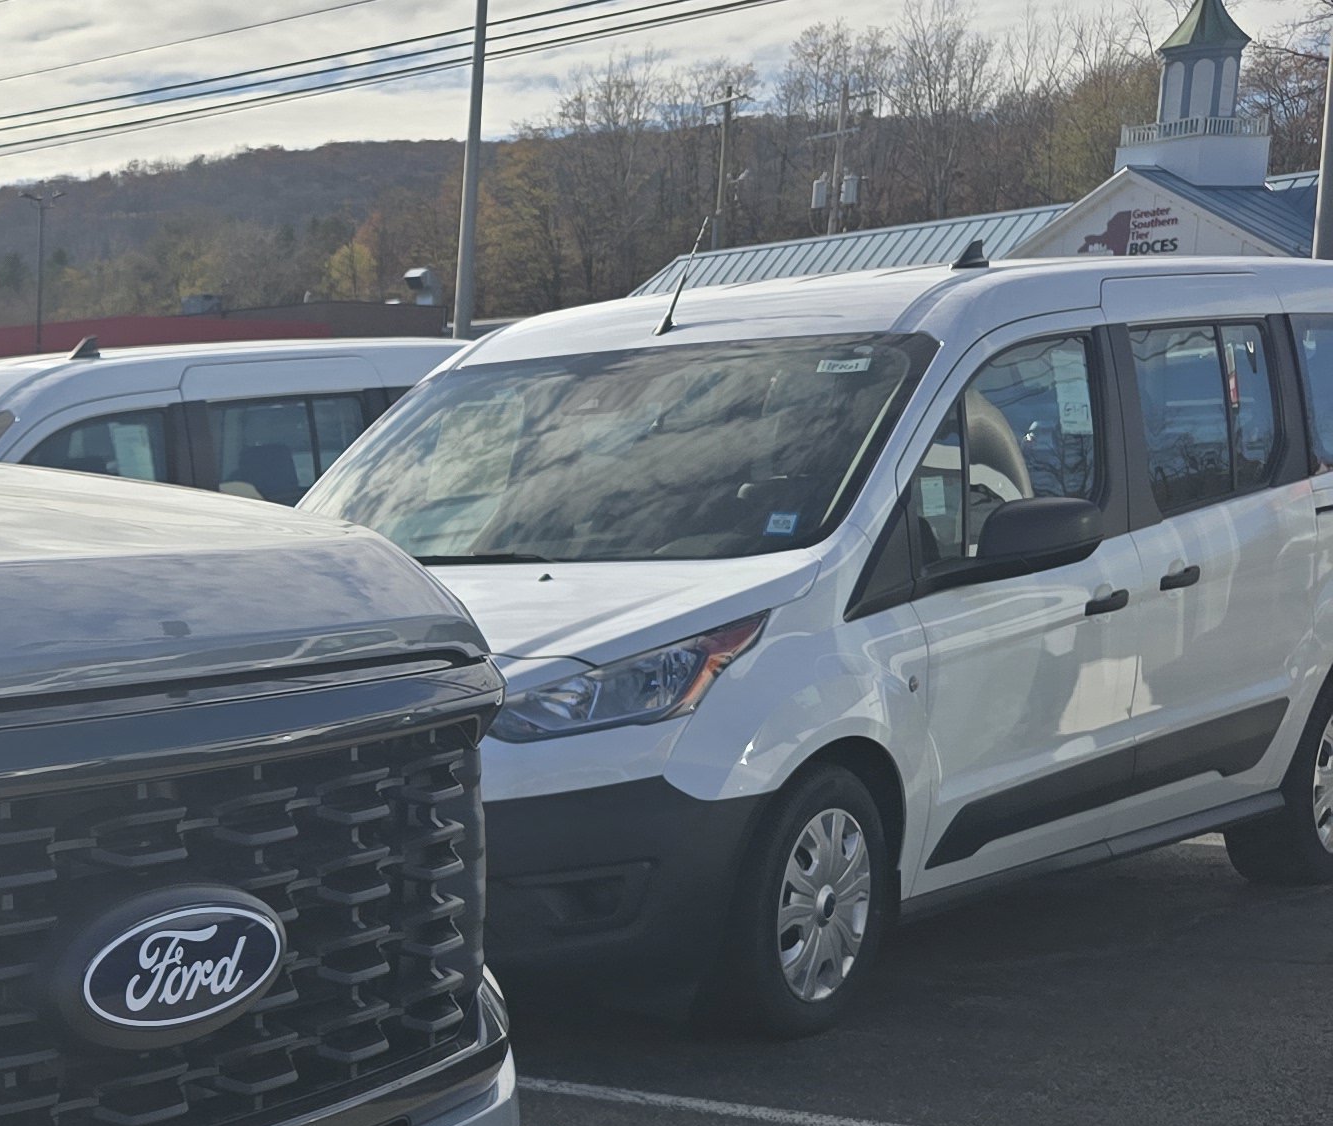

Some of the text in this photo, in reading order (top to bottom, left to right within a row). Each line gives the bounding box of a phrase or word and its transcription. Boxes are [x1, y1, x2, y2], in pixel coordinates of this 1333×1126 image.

[1132, 207, 1171, 219] Greater
[1131, 216, 1179, 230] Southern
[1129, 238, 1179, 256] BOCES
[125, 924, 247, 1012] Ford
